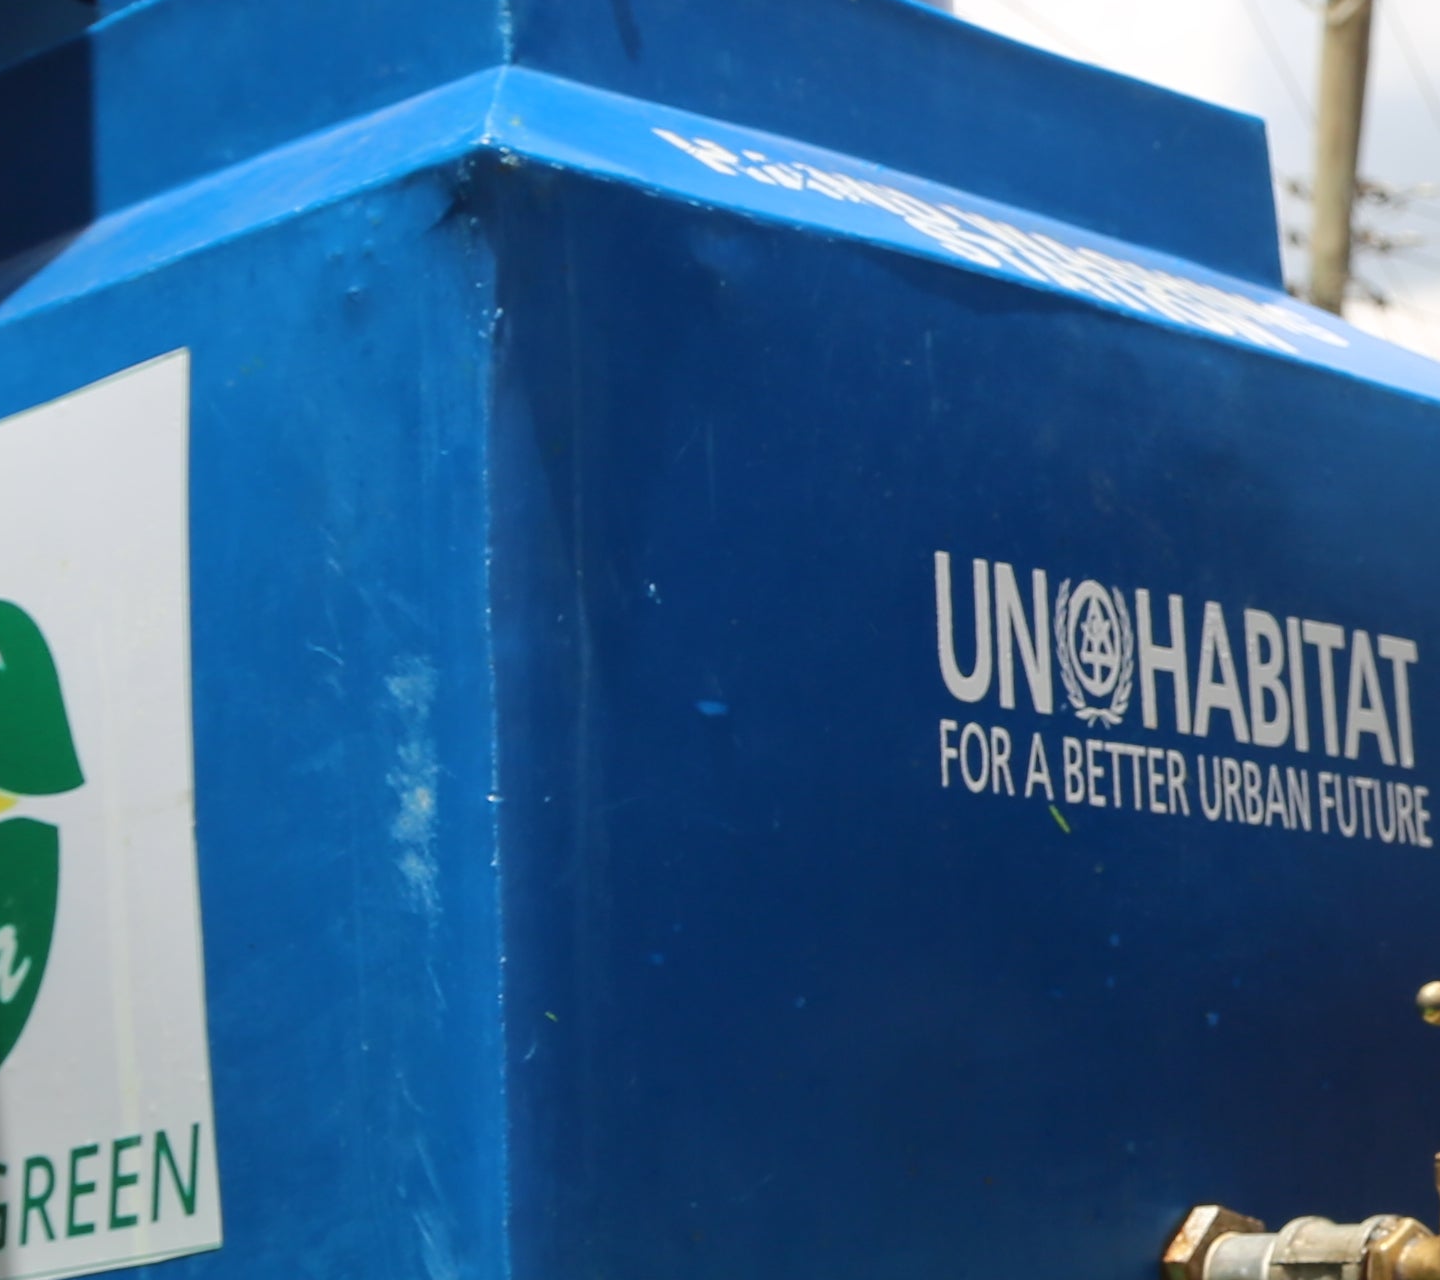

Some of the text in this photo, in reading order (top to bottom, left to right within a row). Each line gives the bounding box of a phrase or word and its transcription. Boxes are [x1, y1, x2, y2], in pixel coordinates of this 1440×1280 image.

[1135, 587, 1418, 769] HABITAT
[940, 719, 1433, 849] FOR A BETTER URBAN FUTURE
